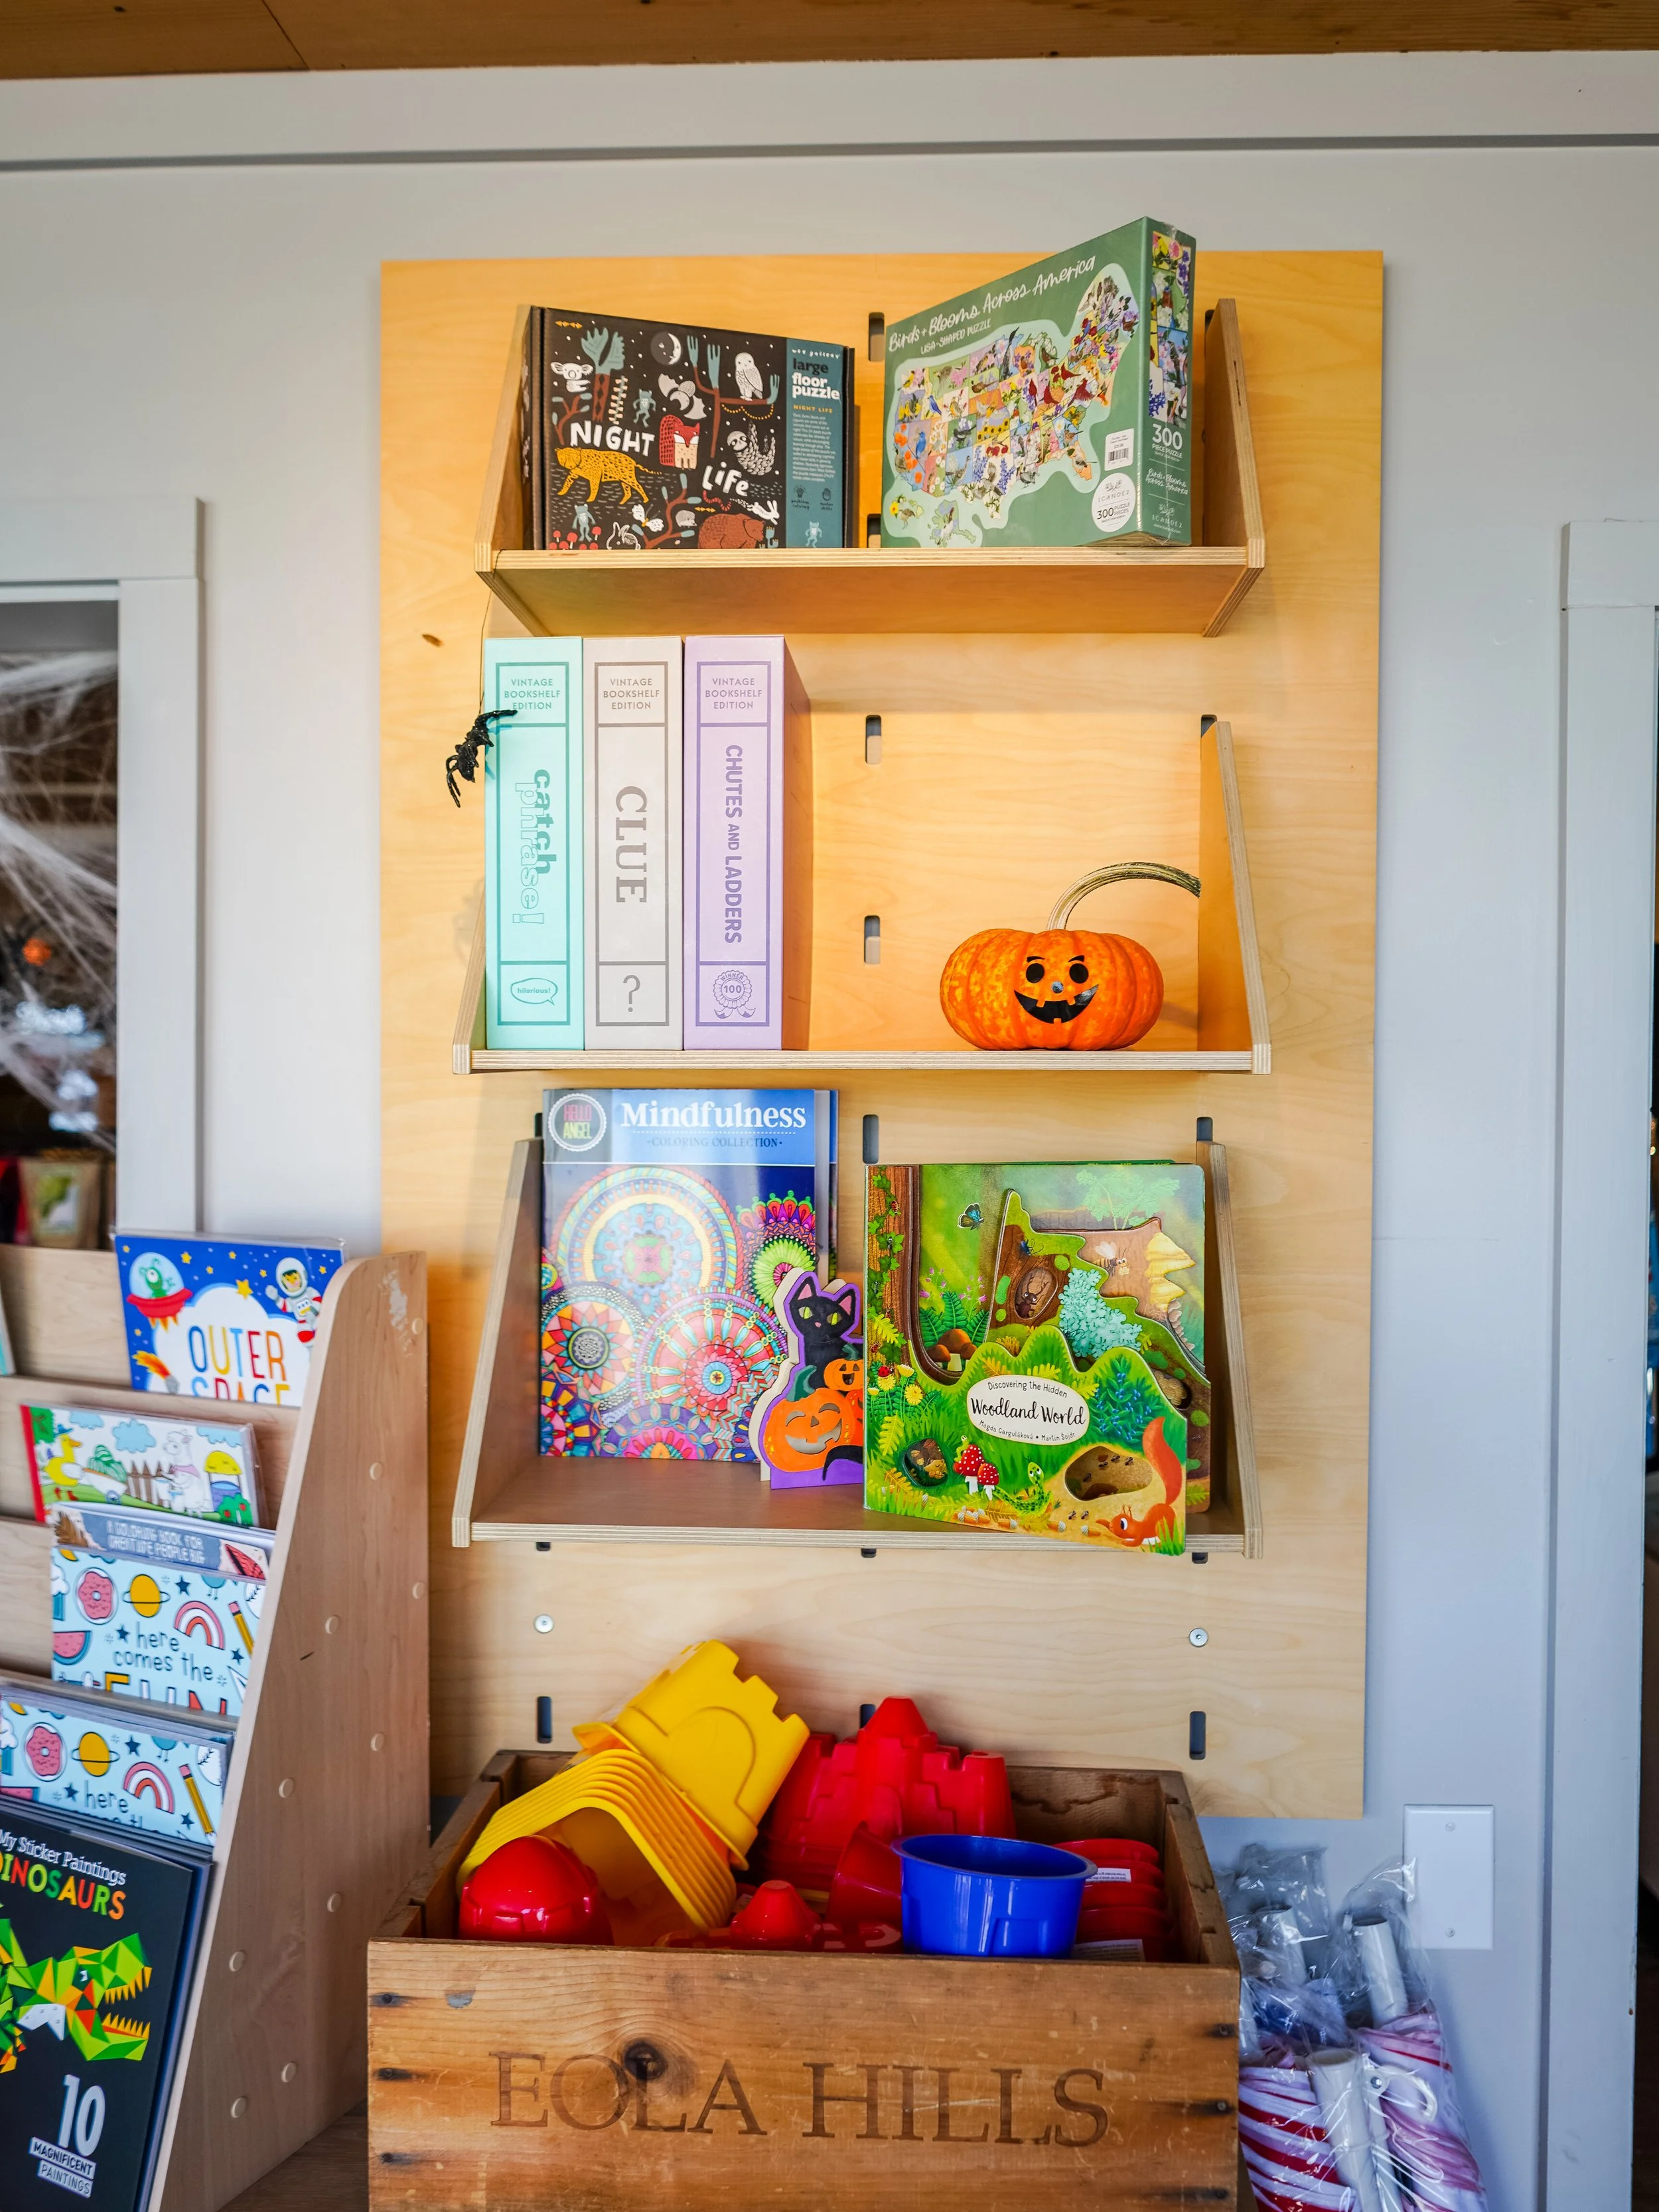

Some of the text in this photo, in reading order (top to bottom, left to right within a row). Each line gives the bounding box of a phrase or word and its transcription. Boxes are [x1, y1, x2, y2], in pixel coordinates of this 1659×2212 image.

[889, 325, 920, 352] Birds
[929, 305, 980, 336] Blooms
[983, 283, 1031, 314] Across
[1033, 255, 1096, 296] America
[920, 318, 991, 355] USA-SHAPED PUZZLE
[792, 372, 828, 388] floor
[793, 358, 829, 376] large
[792, 384, 840, 400] puzzle
[570, 420, 655, 457] NIGHT
[1152, 423, 1183, 450] 300
[1097, 507, 1114, 520] 300
[534, 769, 557, 874] catch
[616, 786, 647, 903] CLUE
[725, 745, 743, 943] CHUTES AND LADDERS
[563, 1104, 592, 1122] HELLO
[620, 1100, 806, 1128] Mindfulness
[563, 1122, 593, 1140] ANGEL
[652, 1137, 778, 1147] COLORING COLLECTION
[188, 1325, 287, 1381] OUTER
[987, 1380, 1068, 1398] Discovering the Hidden
[970, 1397, 1086, 1426] Woodland World
[979, 1420, 997, 1432] Magda
[114, 1521, 158, 1541] COLORING
[158, 1528, 183, 1546] BOOK
[184, 1534, 204, 1550] FOR
[154, 1542, 189, 1562] PEOPLE
[136, 1621, 179, 1652] here
[113, 1651, 213, 1682] comes the
[84, 1779, 129, 1813] here
[17, 1836, 62, 1864] Sticker
[62, 1851, 127, 1886] Paintings
[488, 2050, 1110, 2148] EOLA HILLS
[58, 2074, 106, 2157] 10
[34, 2141, 93, 2175] MAGNIFICENT
[41, 2164, 90, 2194] PAINTINGS
